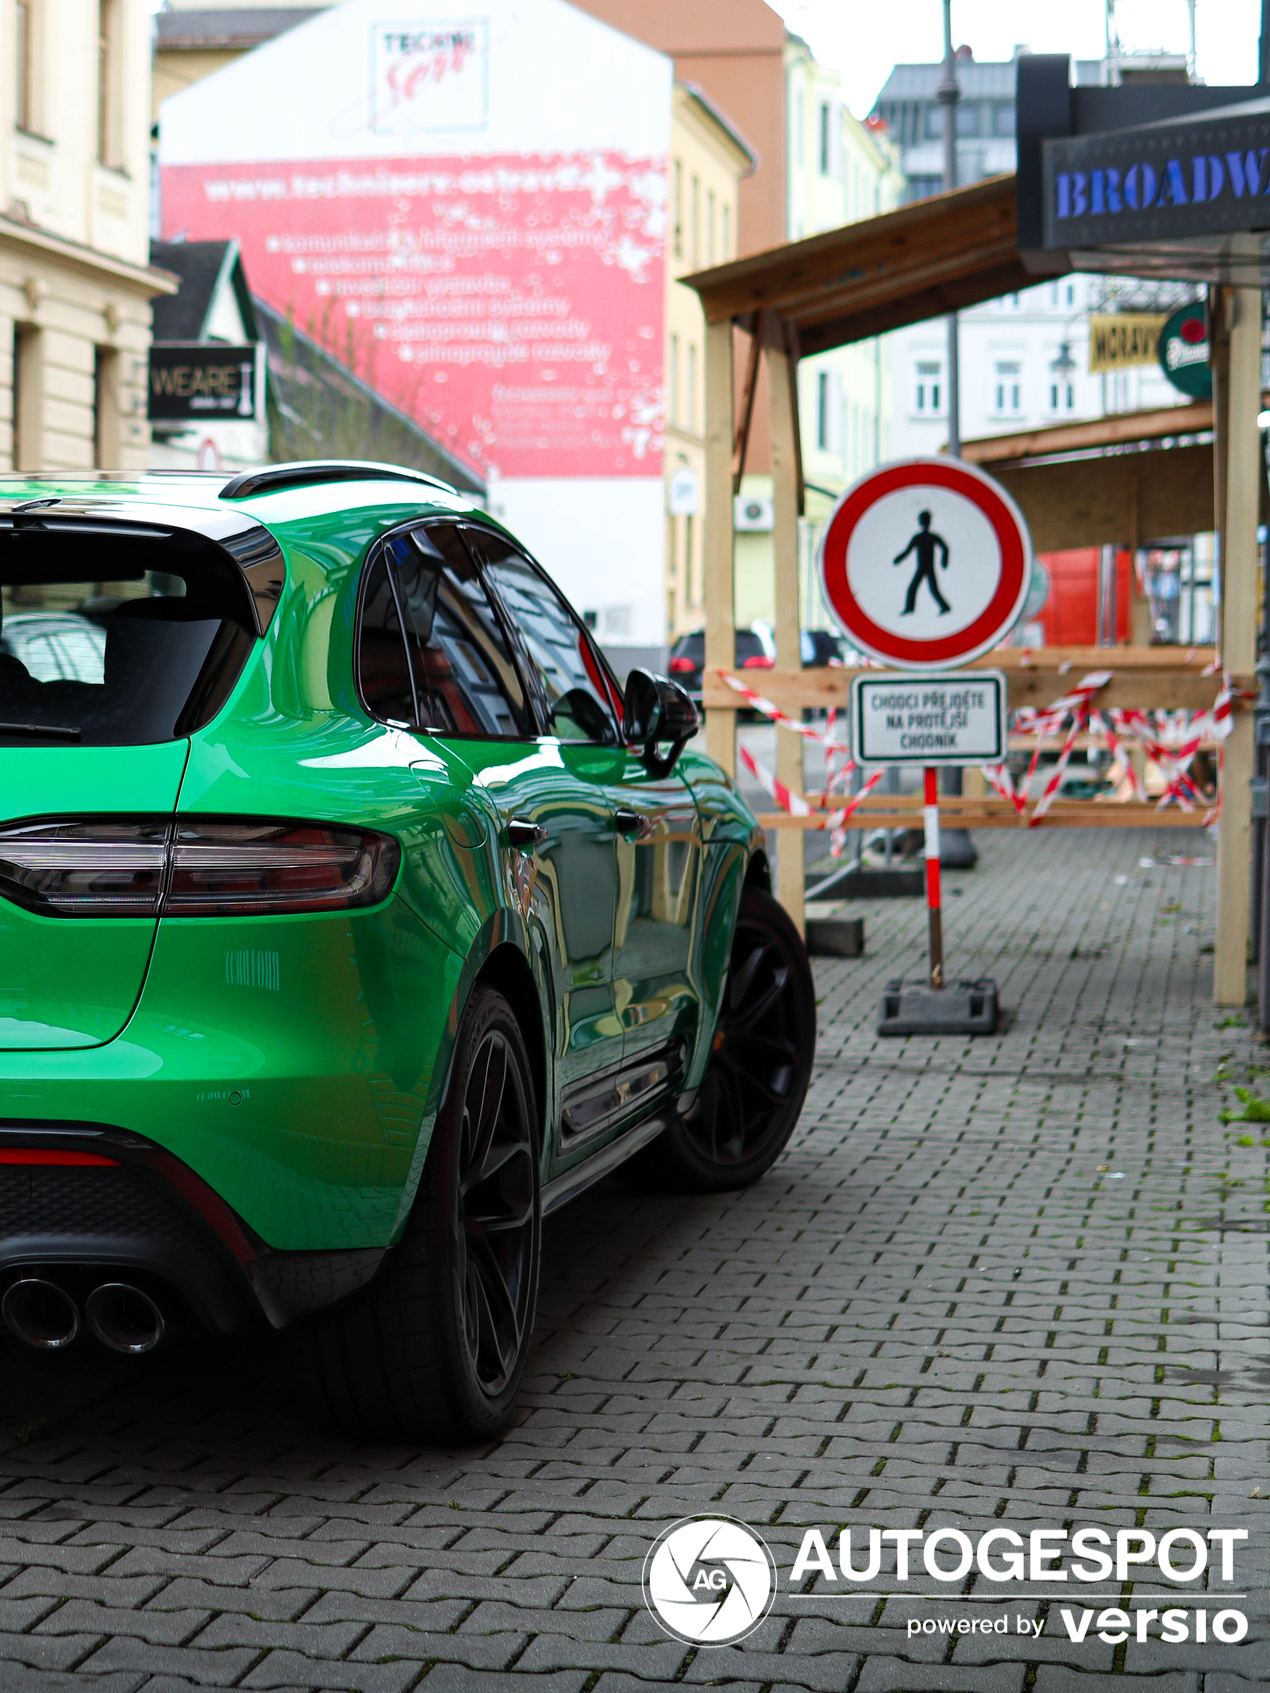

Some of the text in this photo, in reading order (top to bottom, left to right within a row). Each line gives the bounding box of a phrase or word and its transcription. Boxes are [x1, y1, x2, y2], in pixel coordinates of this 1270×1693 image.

[1056, 148, 1270, 218] BROADW
[871, 689, 986, 710] CHODCI PŘEJDĚTE
[886, 711, 968, 729] NA PROTĚJŠÍ
[900, 733, 958, 749] CHODNÍK
